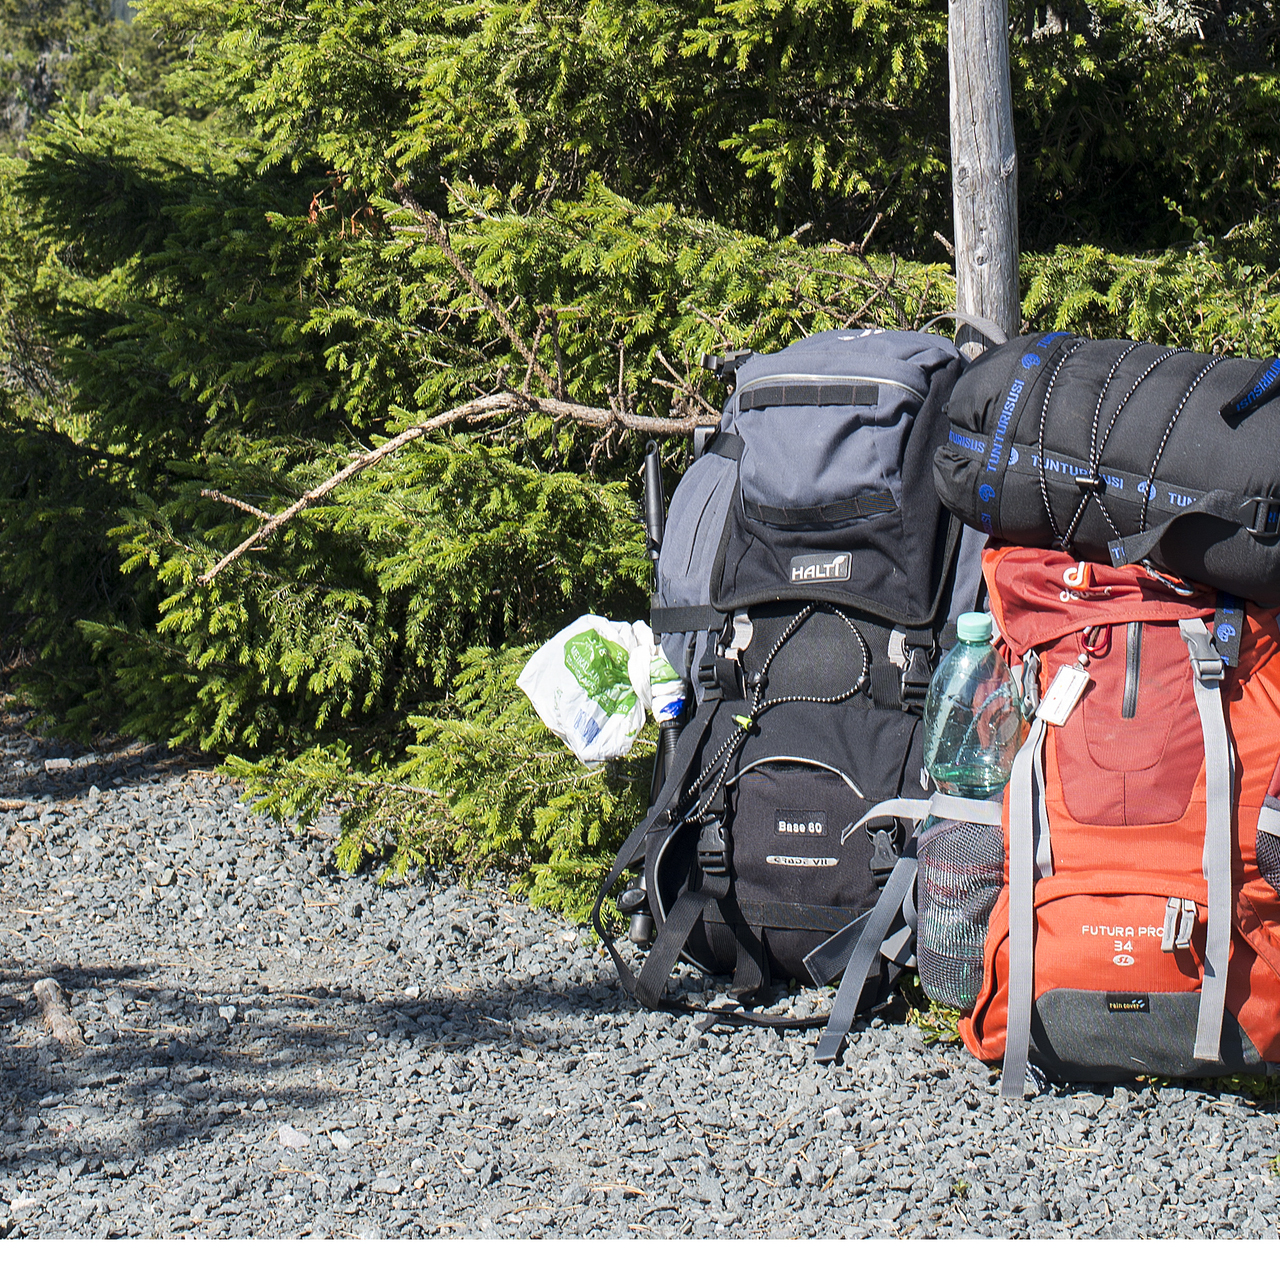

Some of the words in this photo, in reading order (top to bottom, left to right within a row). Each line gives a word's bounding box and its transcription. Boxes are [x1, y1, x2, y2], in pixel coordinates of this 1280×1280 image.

[986, 378, 1025, 473] TUNTURISUSI
[791, 560, 842, 581] HALTI
[1081, 925, 1135, 937] FUTURA
[1138, 926, 1165, 937] PRO
[1114, 940, 1133, 952] 34
